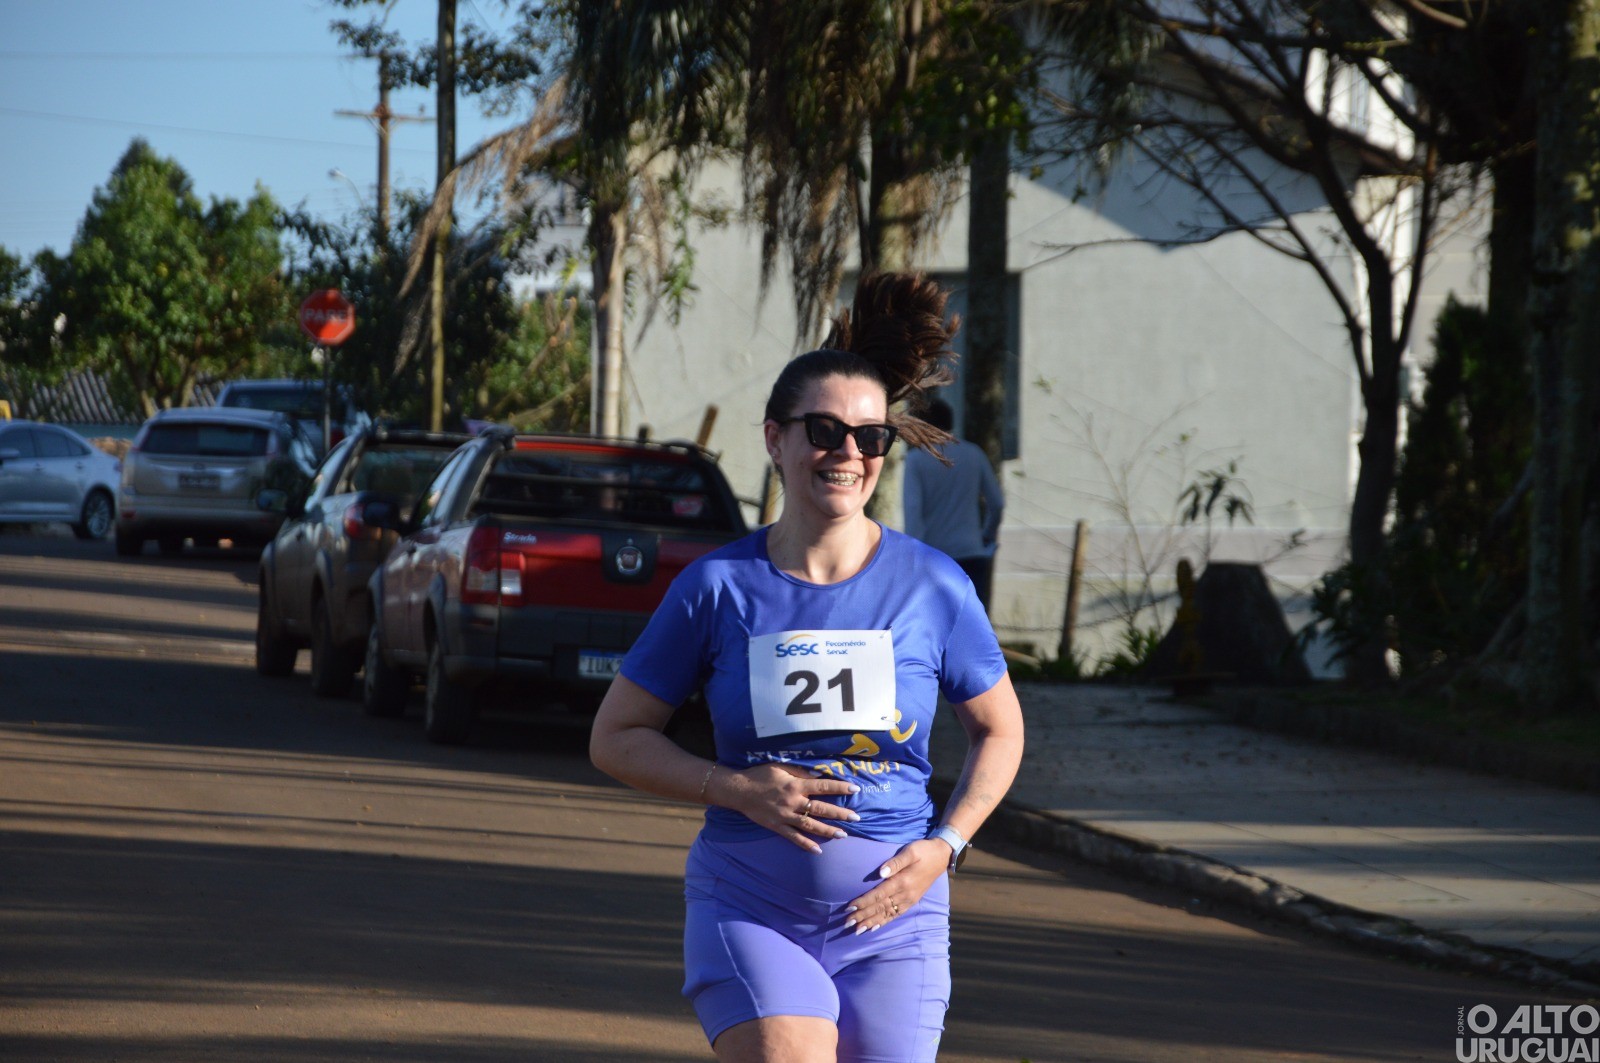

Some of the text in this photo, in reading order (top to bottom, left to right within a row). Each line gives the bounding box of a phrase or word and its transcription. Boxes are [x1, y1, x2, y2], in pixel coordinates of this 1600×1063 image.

[304, 309, 347, 323] PARE
[504, 532, 537, 545] Strada
[784, 668, 855, 716] 21
[746, 750, 815, 763] ATLETA
